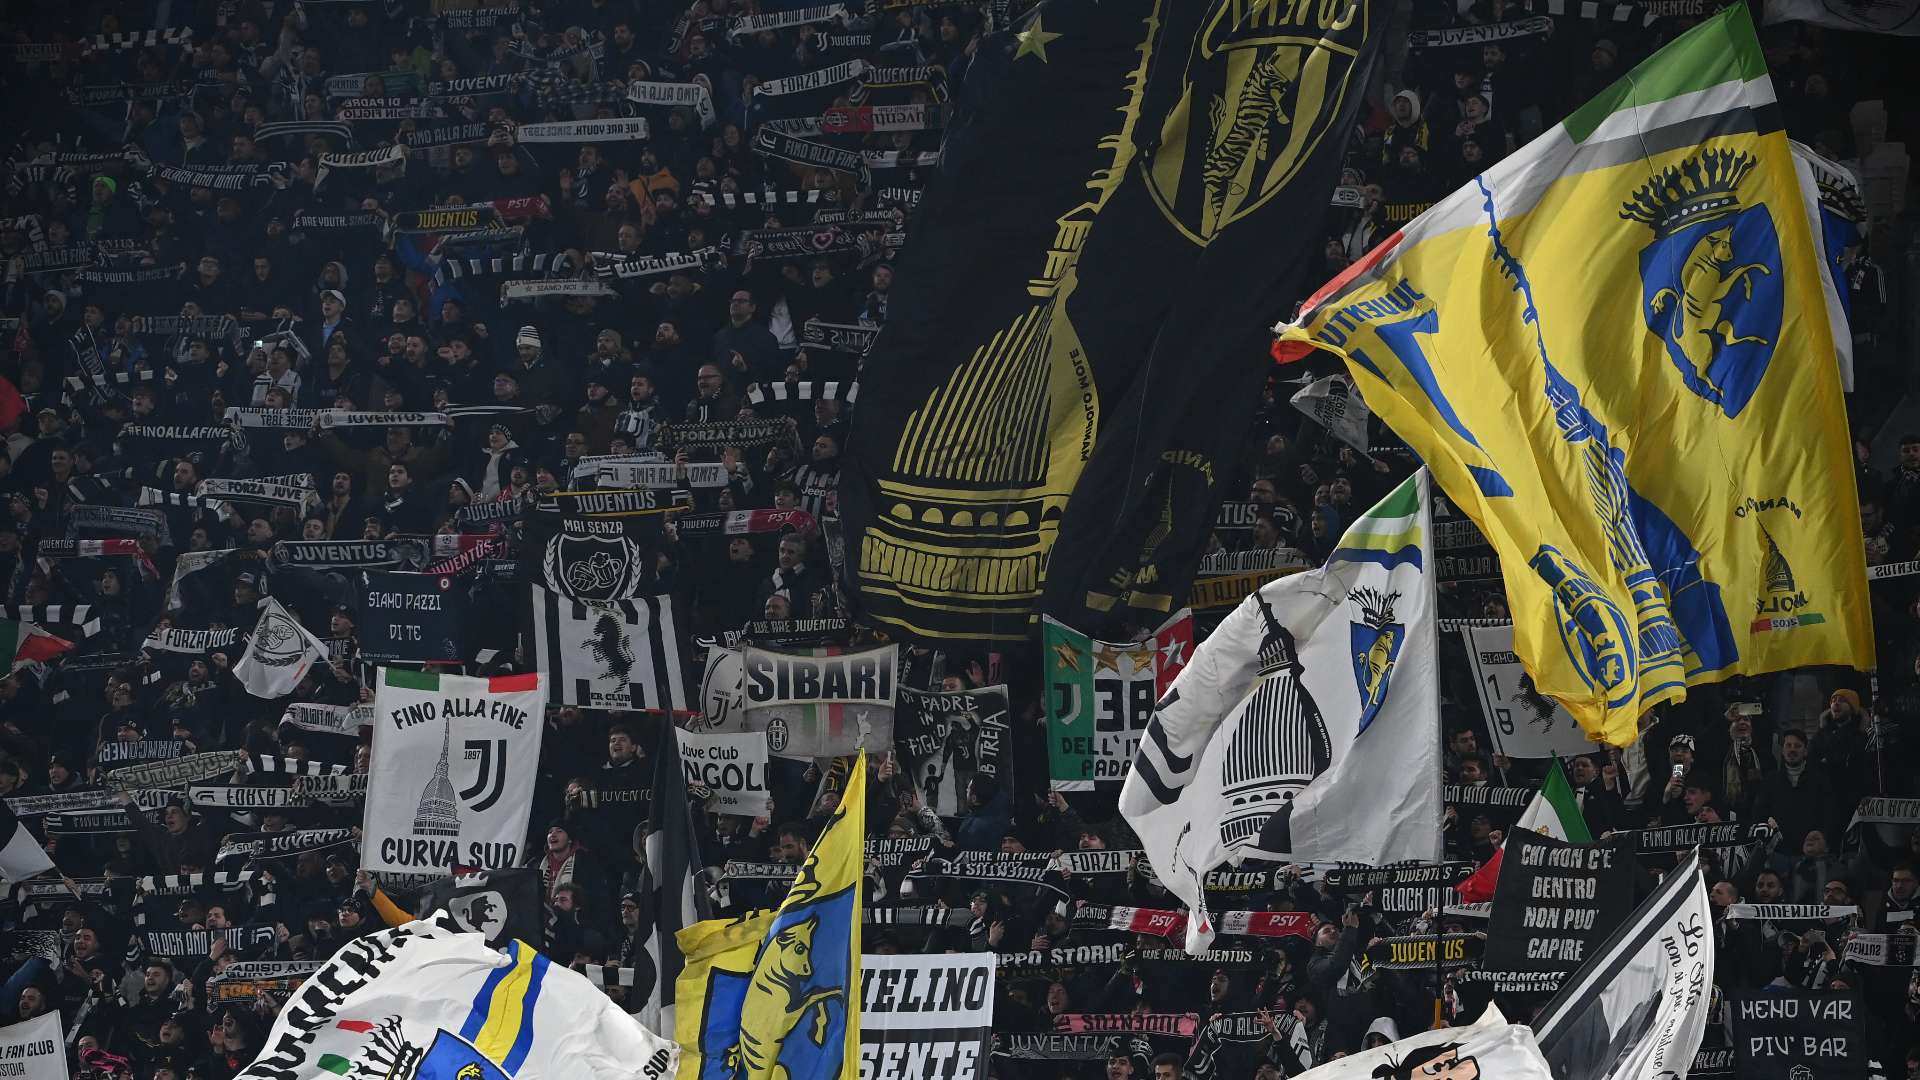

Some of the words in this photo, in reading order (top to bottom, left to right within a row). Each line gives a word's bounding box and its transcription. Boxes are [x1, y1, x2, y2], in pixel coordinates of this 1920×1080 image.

[831, 35, 872, 47] JUVENTUS
[1438, 25, 1516, 46] JUVENTUS
[449, 74, 513, 91] JUVENT
[823, 63, 852, 84] JUVE
[507, 199, 531, 209] PSV
[417, 210, 479, 229] JUVENTUS
[348, 412, 427, 425] JUVENTUS
[128, 425, 229, 440] #FINOALLAFINE
[227, 482, 266, 496] FORZA
[271, 487, 302, 500] JUVE
[800, 487, 827, 498] Jeep
[576, 491, 656, 513] JUVENTUS
[682, 517, 721, 529] JUVENTUS
[767, 510, 794, 524] PSV
[564, 520, 590, 537] MAI
[591, 521, 624, 539] SENZA
[293, 544, 387, 567] JUVENTUS
[368, 593, 403, 609] SIAMO
[406, 592, 442, 611] PAZZI
[389, 624, 402, 641] DI
[405, 623, 423, 640] TE
[752, 620, 769, 634] WE
[771, 619, 791, 633] ARE
[794, 618, 847, 634] JUVENTUS
[165, 628, 206, 649] FORZA
[1482, 653, 1514, 667] SIAMO
[747, 655, 891, 703] SIBARI
[605, 693, 631, 703] CLUB
[920, 695, 979, 713] PADRE
[391, 697, 437, 730] FINO
[442, 697, 487, 720] ALLA
[491, 701, 529, 730] FINE
[464, 749, 480, 761] 1897
[681, 742, 707, 758] Juve
[708, 746, 740, 760] Club
[717, 797, 738, 806] 1984
[270, 831, 352, 856] JUVENT
[1642, 830, 1670, 848] FINO
[1674, 828, 1707, 846] ALLA
[1709, 824, 1738, 843] FINE
[380, 837, 460, 868] CURVA
[467, 841, 517, 869] SUD
[879, 841, 893, 857] IN
[895, 840, 931, 856] FIGLIO
[1521, 844, 1547, 869] CHI
[1547, 846, 1584, 870] NON
[1071, 852, 1121, 872] FORZA
[1347, 873, 1365, 887] WE
[1531, 875, 1597, 901] DENTRO
[1381, 886, 1425, 912] BLACK
[1149, 914, 1173, 928] PSV
[1269, 914, 1300, 927] PSV
[1523, 905, 1562, 930] NON
[148, 931, 184, 956] BLACK
[186, 930, 208, 956] AND
[1678, 912, 1704, 958] Lo
[1142, 949, 1162, 963] WE
[1390, 939, 1465, 963] JUVENUS
[1526, 936, 1585, 962] CAPIRE
[1661, 935, 1682, 968] non
[1493, 981, 1560, 993] FIGHTERS
[1809, 998, 1852, 1021] VAR
[5, 1046, 26, 1060] FAN
[27, 1039, 55, 1058] CLUB
[1007, 1033, 1120, 1056] JUVENTUS
[1803, 1036, 1848, 1057] BAR
